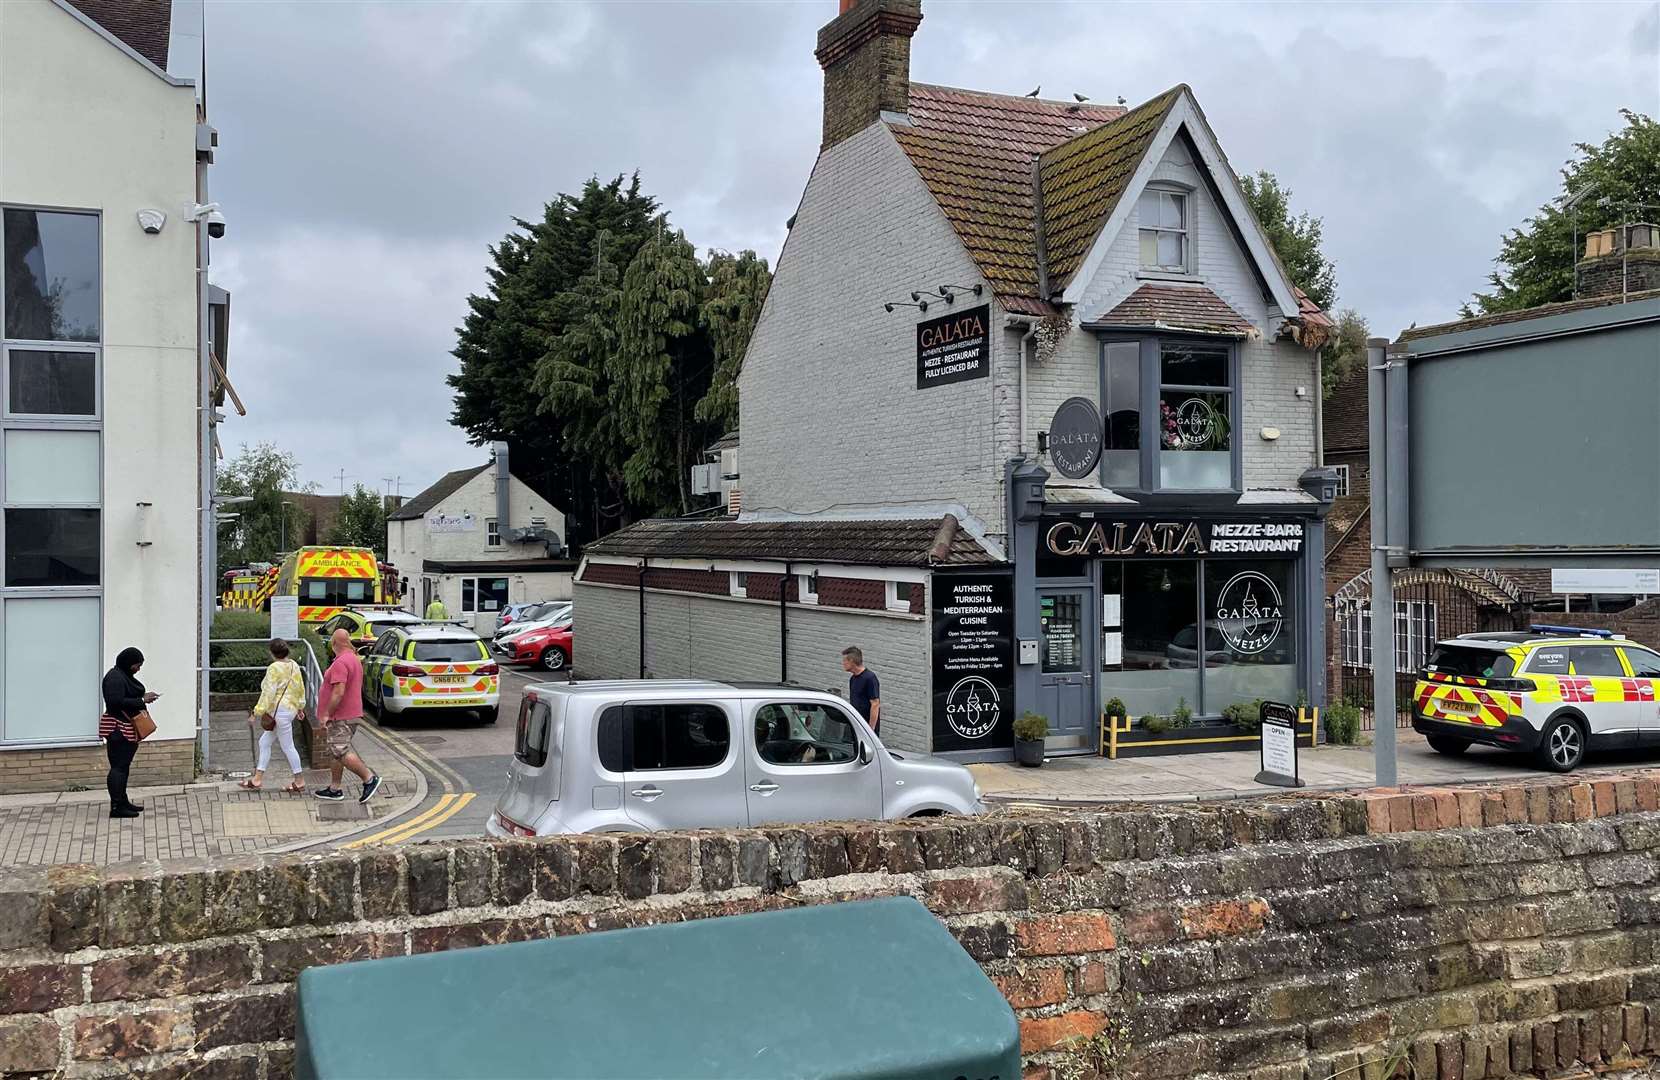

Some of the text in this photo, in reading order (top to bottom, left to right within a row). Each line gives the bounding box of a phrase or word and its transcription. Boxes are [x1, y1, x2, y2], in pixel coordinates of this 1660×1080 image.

[921, 315, 985, 348] GALATA
[922, 337, 983, 357] AUTHENTIC TURKISH RESTAURANT
[924, 357, 941, 368] MEZZE
[944, 348, 980, 363] RESTAURANT
[925, 360, 979, 379] FULLY LICENCED BAR
[1177, 417, 1214, 426] GALATA
[1051, 432, 1098, 445] GALATA
[1185, 432, 1206, 442] MEZZE
[1056, 449, 1093, 471] RESTAURANT
[1046, 521, 1208, 555] GALATA
[1210, 540, 1302, 553] RESTAURANT
[312, 559, 361, 567] AMBULANCE
[953, 585, 993, 593] AUTHENTIC
[954, 595, 992, 603] TURKISH &
[943, 606, 1003, 614] MEDITERRANEAN
[1217, 607, 1282, 619] GALATA
[960, 617, 988, 625] CUISINE
[1232, 633, 1269, 649] MEZZE
[946, 702, 1000, 713] GALATA
[958, 722, 989, 735] MEZZE
[1271, 727, 1285, 736] OPEN
